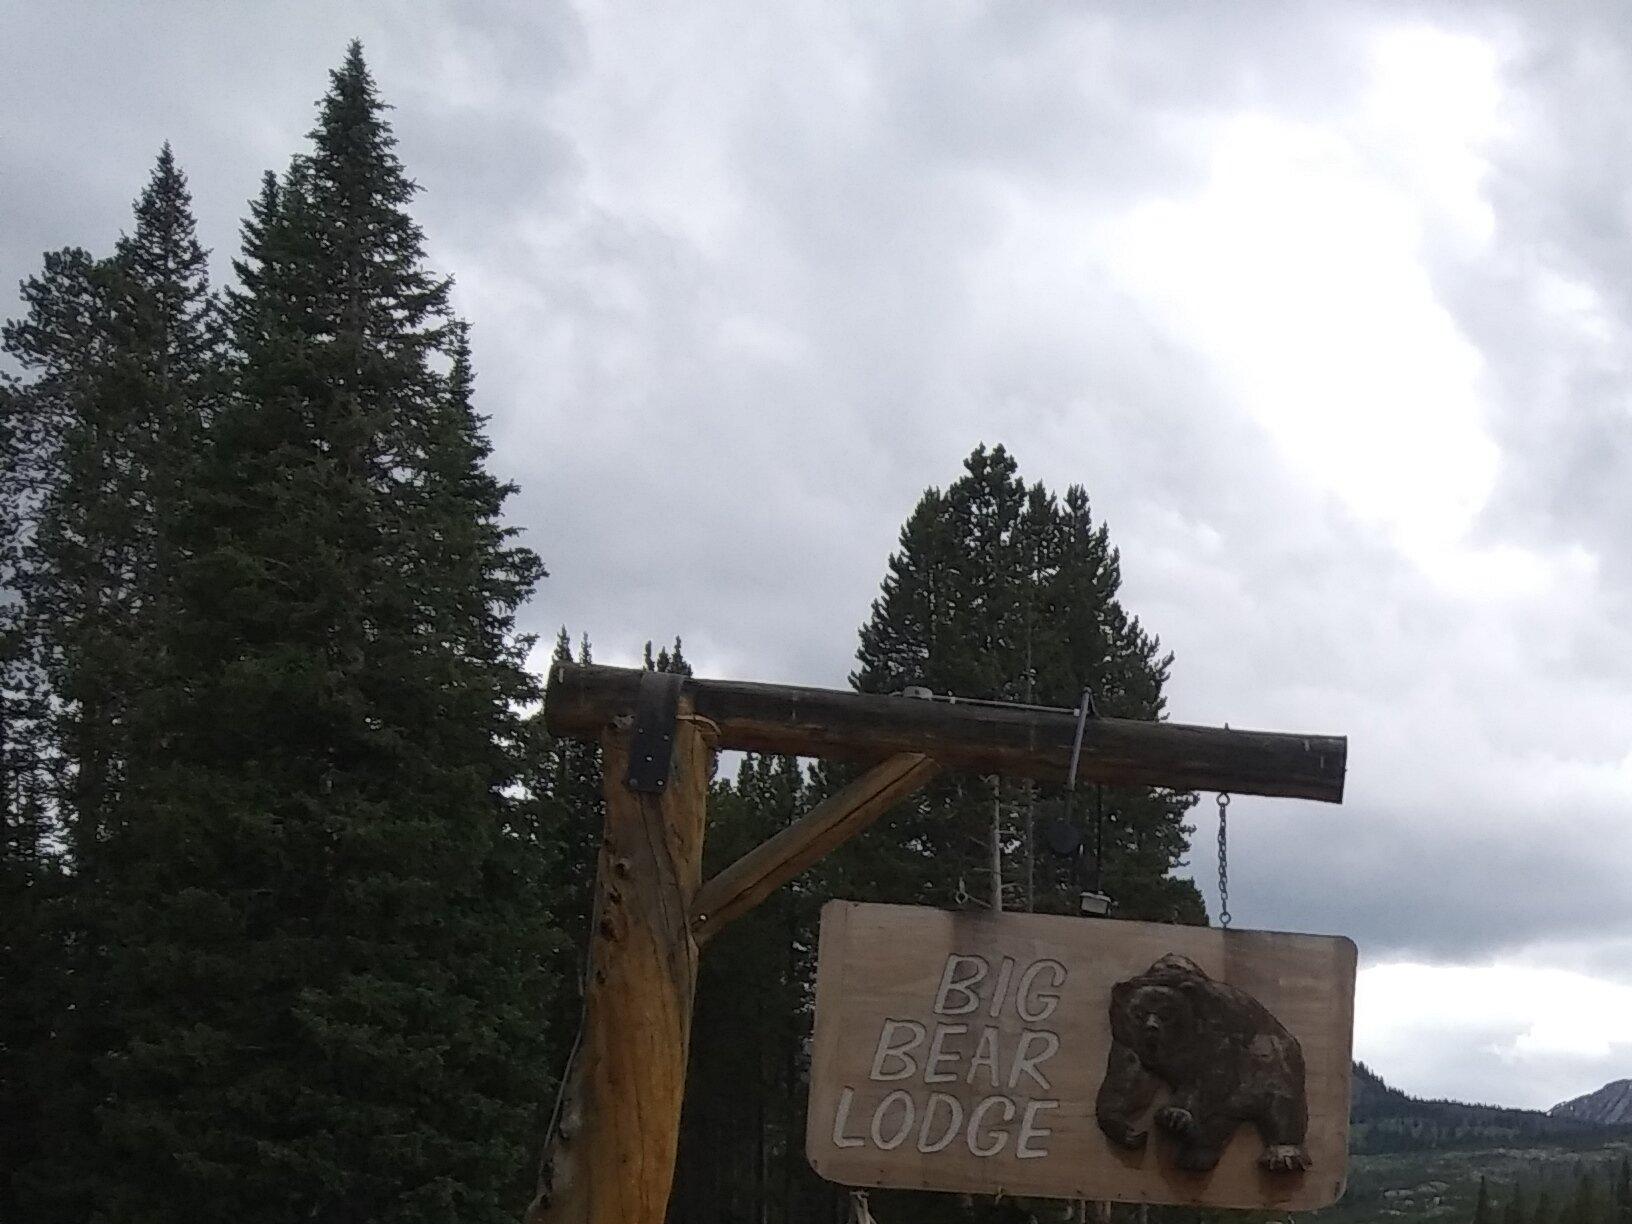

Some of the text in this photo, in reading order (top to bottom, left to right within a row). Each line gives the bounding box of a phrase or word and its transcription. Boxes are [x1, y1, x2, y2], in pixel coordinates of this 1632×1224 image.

[933, 954, 1068, 1023] BIG
[870, 1018, 1060, 1090] BEAR
[833, 1087, 1060, 1159] LODGE
